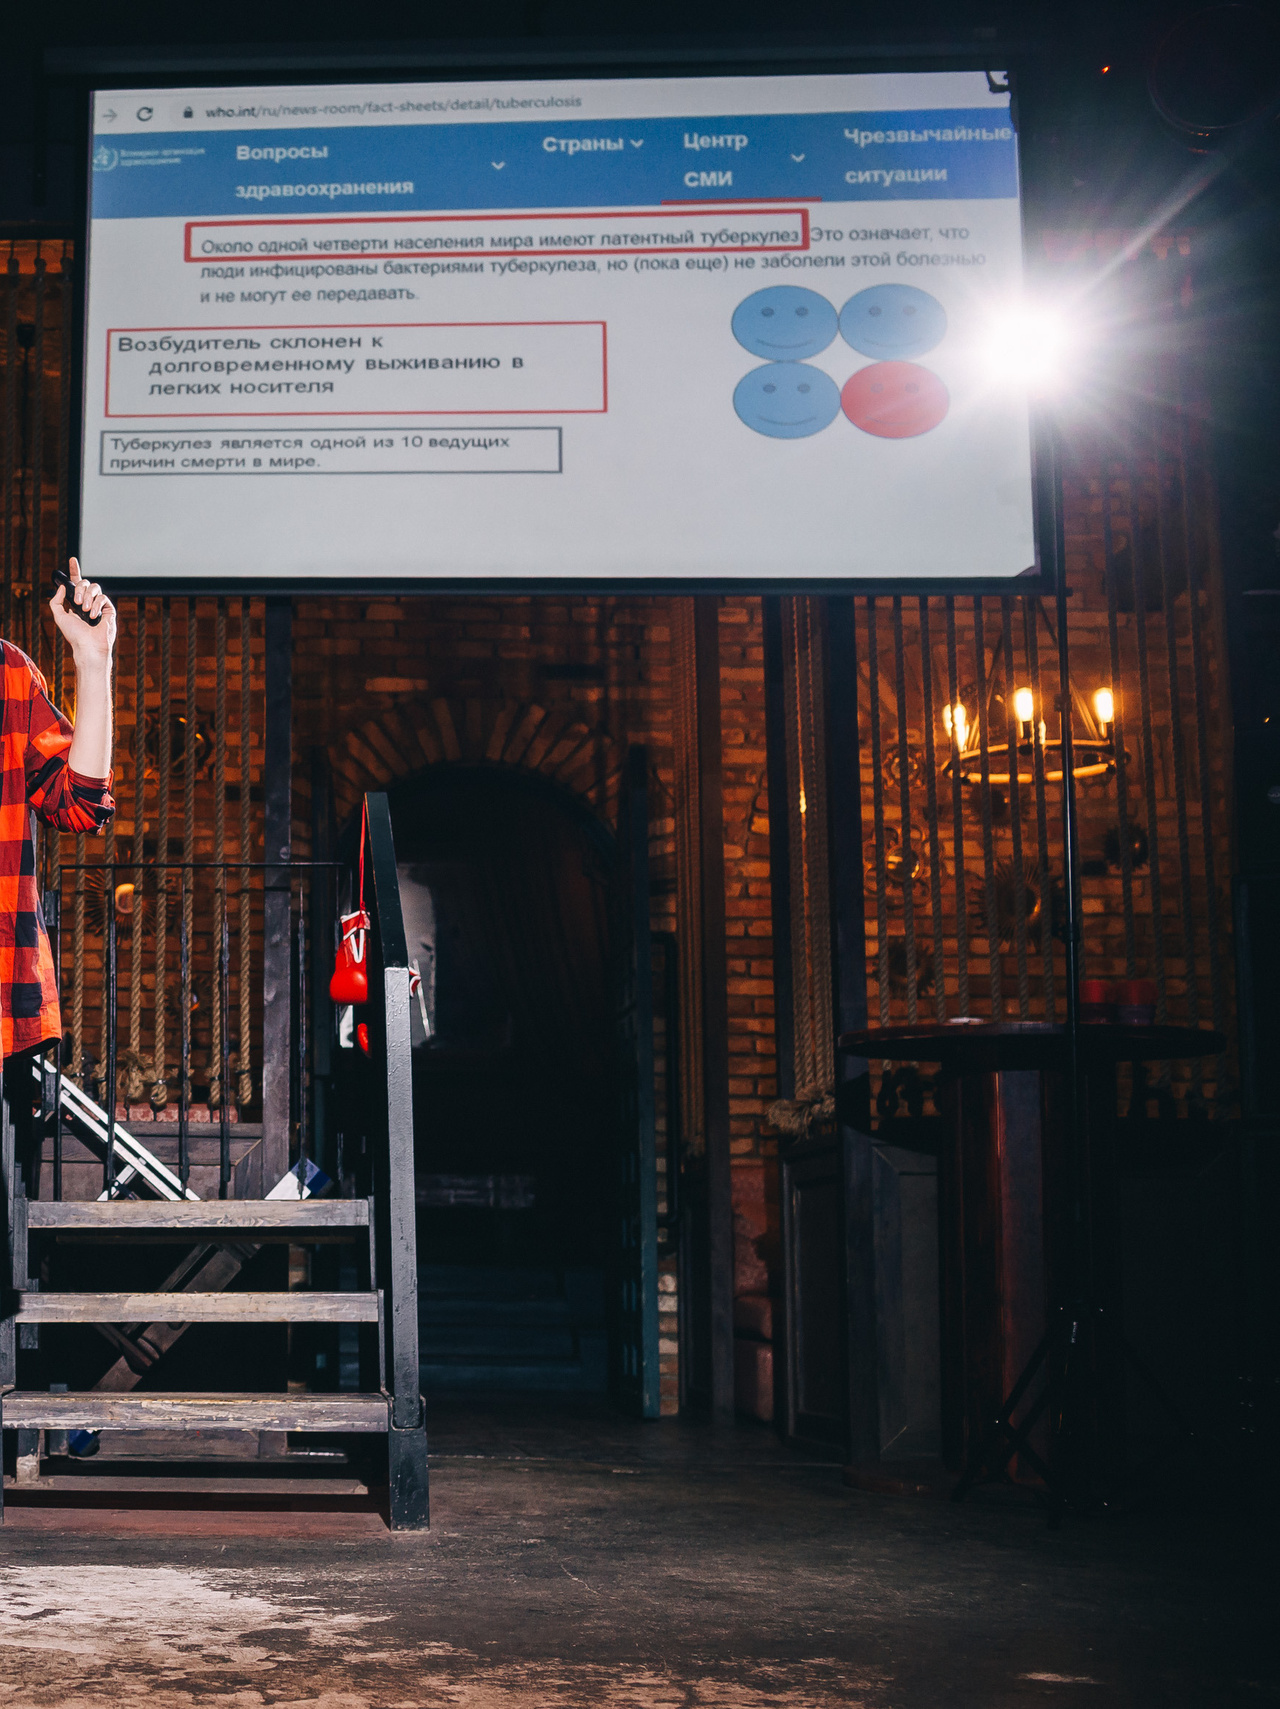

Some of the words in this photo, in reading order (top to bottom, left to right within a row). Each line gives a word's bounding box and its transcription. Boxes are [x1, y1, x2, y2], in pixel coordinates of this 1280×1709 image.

[205, 96, 582, 119] who.int/ru/news-room/fact-sheets/detail/tuberculosis
[542, 135, 624, 155] Страны
[683, 132, 748, 150] Центр
[843, 126, 1012, 148] Чрезвычайные
[236, 145, 329, 163] Вопросы
[683, 171, 733, 188] СМИ
[845, 168, 948, 187] ситуации
[235, 180, 414, 200] здравоохранения
[201, 239, 253, 254] Около
[258, 238, 308, 254] одной
[313, 237, 388, 253] четверти
[394, 235, 484, 250] населения
[490, 235, 533, 250] мира
[539, 233, 595, 247] имеют
[600, 229, 694, 246] латентный
[810, 226, 843, 242] Это
[848, 226, 933, 243] означает,
[939, 226, 970, 240] что
[200, 263, 245, 279] люди
[249, 262, 378, 280] инфицированы
[383, 259, 484, 276] бактериями
[490, 256, 601, 276] туберкулеза,
[607, 258, 627, 271] но
[633, 255, 681, 274] (пока
[685, 254, 728, 272] еще)
[734, 255, 756, 269] не
[761, 251, 845, 268] заболели
[851, 251, 891, 267] этой
[896, 250, 986, 267] болезнью
[200, 291, 210, 303] и
[215, 290, 235, 303] не
[241, 288, 286, 305] могут
[291, 289, 312, 302] ее
[118, 336, 261, 354] Возбудитель
[270, 336, 362, 349] склонен
[372, 336, 384, 348] к
[148, 358, 355, 375] долговременному
[365, 356, 501, 370] выживанию
[511, 357, 524, 369] в
[148, 382, 221, 396] легких
[230, 381, 335, 394] носителя
[110, 438, 212, 453] Туберкулез
[220, 437, 303, 450] является
[310, 436, 366, 450] одной
[373, 437, 394, 448] из
[402, 435, 423, 448] 10
[428, 436, 510, 450] ведущих
[110, 458, 175, 471] причин
[181, 457, 246, 470] смерти
[252, 457, 262, 468] в
[269, 456, 321, 470] мире.
